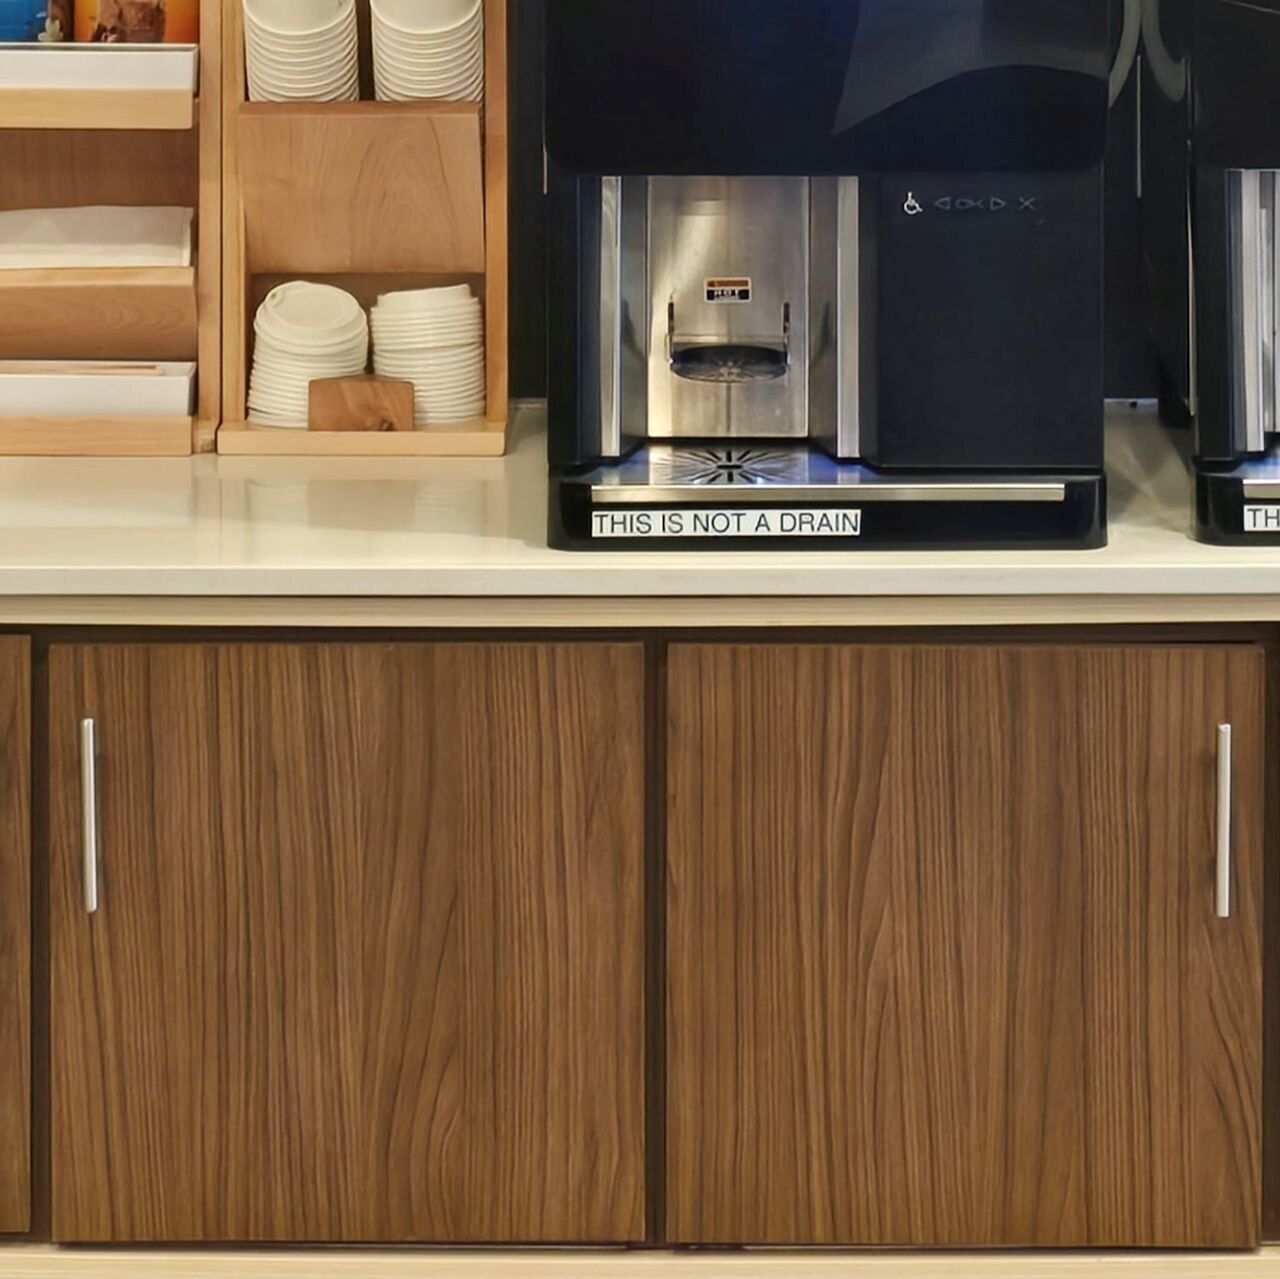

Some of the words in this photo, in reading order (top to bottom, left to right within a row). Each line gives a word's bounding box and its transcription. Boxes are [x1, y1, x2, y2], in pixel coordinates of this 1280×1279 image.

[594, 512, 652, 533] THIS
[662, 512, 684, 533] IS
[693, 512, 746, 533] NOT
[754, 512, 772, 533] A
[780, 512, 859, 533] DRAIN
